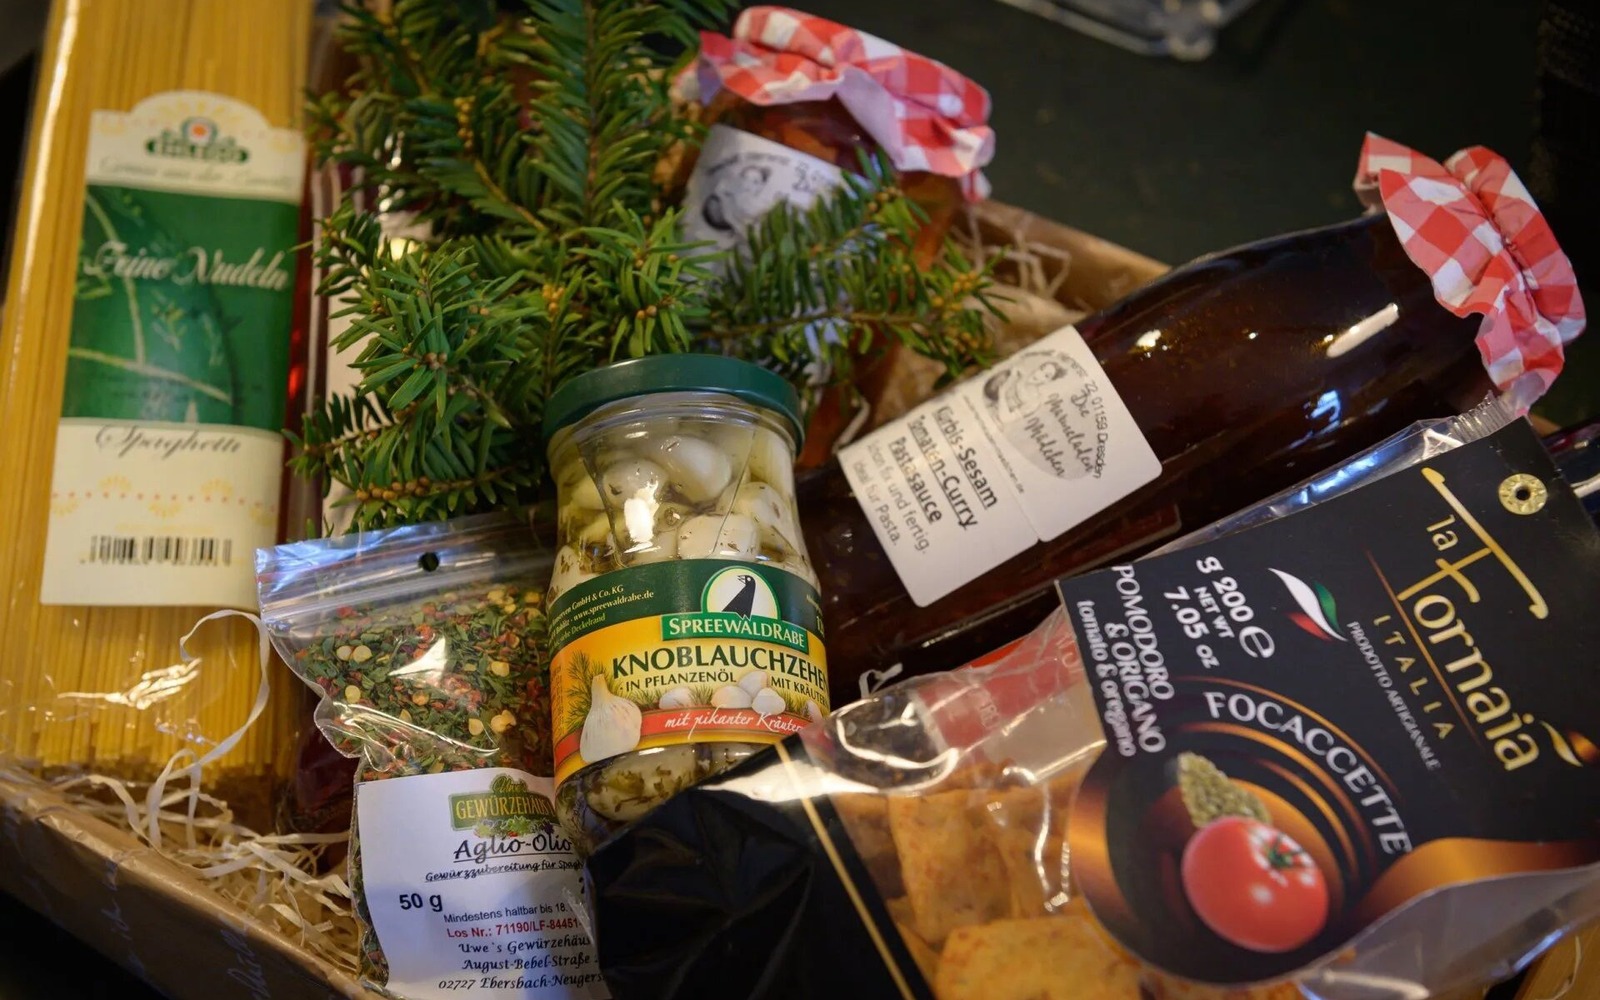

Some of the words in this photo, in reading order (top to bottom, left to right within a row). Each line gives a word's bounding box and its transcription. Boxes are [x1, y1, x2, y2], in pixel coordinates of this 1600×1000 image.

[171, 246, 288, 291] Nudeln
[95, 425, 242, 460] Spaghetti
[888, 482, 909, 511] und
[890, 437, 943, 523] Pastasauce
[875, 504, 901, 546] Pasta.
[1426, 514, 1460, 551] la
[571, 595, 592, 610] GmbH
[599, 589, 611, 599] Co.
[611, 584, 624, 595] KG
[573, 590, 654, 621] www.spreewaldrabe.de
[1193, 586, 1220, 614] NET
[1212, 614, 1235, 639] WT
[1212, 576, 1255, 623] 200
[669, 617, 805, 649] SPREEWALDRABE
[1077, 600, 1109, 662] tomato
[1104, 622, 1129, 639] &
[1111, 564, 1175, 700] POMODORO
[1164, 586, 1210, 640] 7.05
[1196, 644, 1220, 669] oz
[1398, 467, 1549, 771] Fornaia
[626, 680, 641, 693] IN
[645, 667, 737, 687] PFLANZENÖL
[771, 676, 791, 690] MIT
[1096, 662, 1118, 679] &
[1373, 614, 1455, 740] ITALIA
[1111, 643, 1167, 753] ORIGANO
[1347, 620, 1393, 689] PRODOTTO
[1387, 688, 1441, 771] ARTIGIANALE
[664, 713, 690, 729] mit
[688, 704, 754, 740] pikanter
[1101, 680, 1137, 757] oregano
[1202, 691, 1413, 855] FOCACCETTE
[453, 834, 573, 864] Aglio-Olio
[425, 861, 541, 882] Gewürzzubereitung
[541, 859, 555, 869] für
[400, 892, 424, 911] 50
[429, 893, 443, 912] g
[443, 909, 503, 923] Mindestens
[504, 904, 538, 919] haltbar
[540, 902, 553, 914] bis
[447, 928, 468, 939] Los
[471, 927, 492, 938] Nr.:
[461, 951, 591, 974] August-Bebel-Straße
[438, 979, 476, 991] 02727
